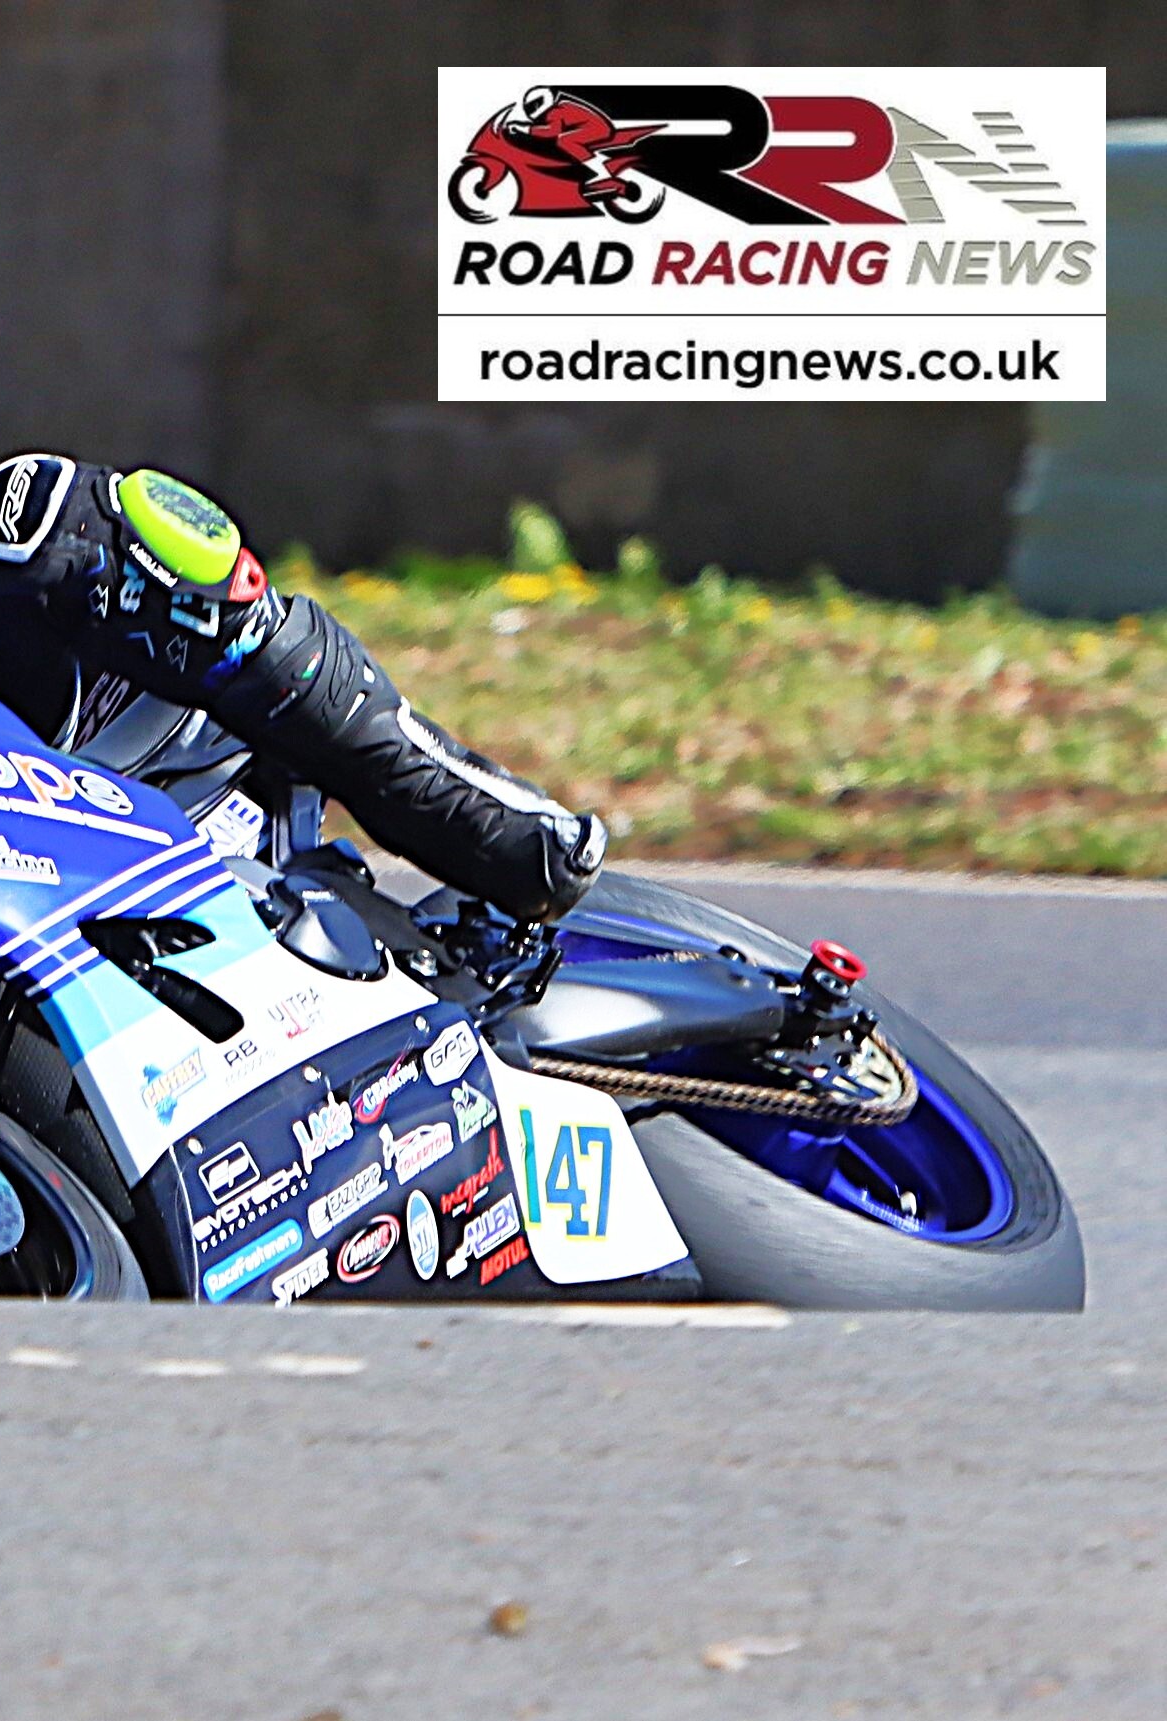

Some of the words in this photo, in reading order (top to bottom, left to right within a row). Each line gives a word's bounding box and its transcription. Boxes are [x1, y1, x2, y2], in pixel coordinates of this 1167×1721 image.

[193, 1161, 303, 1241] EVOTECH
[201, 1178, 309, 1253] PERFORMANCE
[272, 1248, 329, 1308] SPIDER
[480, 1236, 530, 1286] MOTUL
